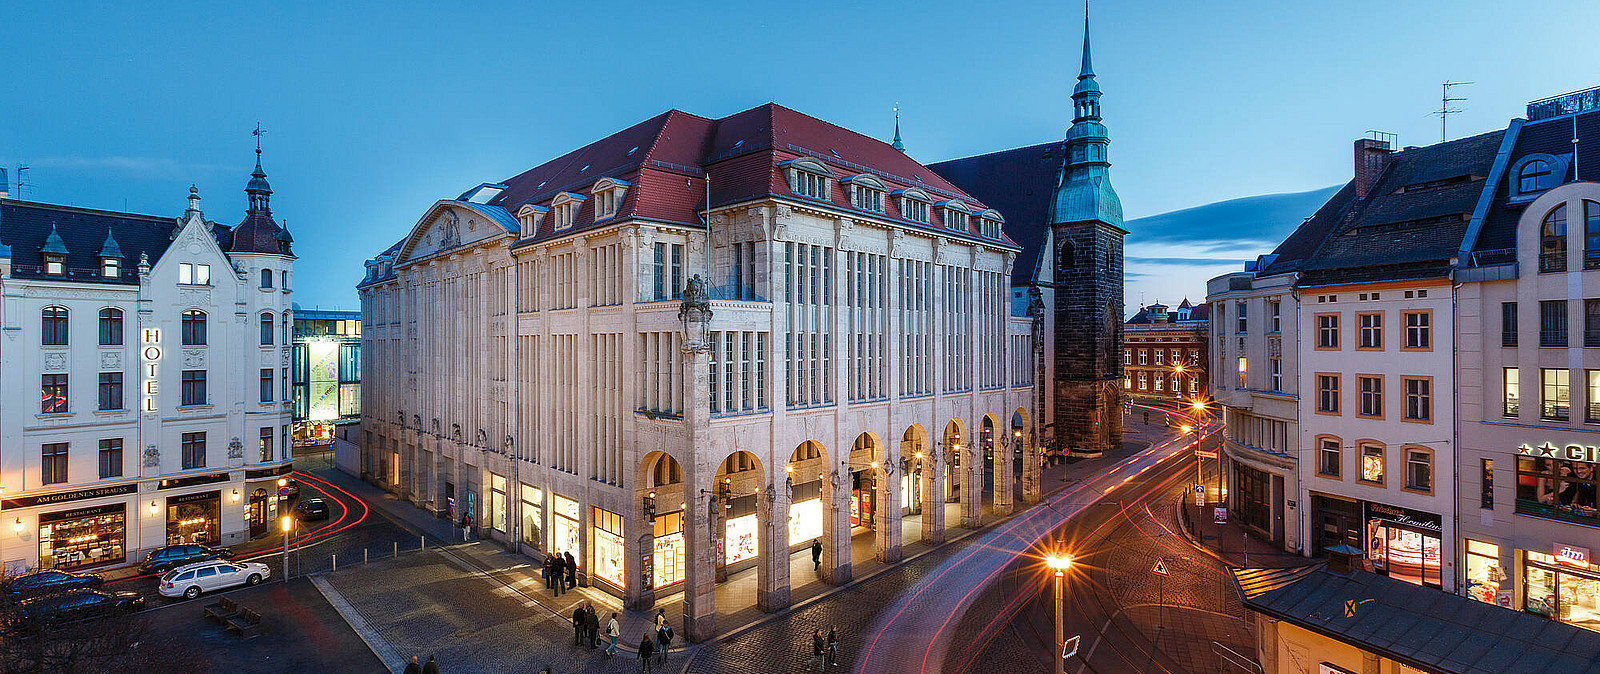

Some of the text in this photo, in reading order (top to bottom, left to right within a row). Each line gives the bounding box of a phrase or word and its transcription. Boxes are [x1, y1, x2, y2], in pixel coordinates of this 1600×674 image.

[144, 329, 161, 412] HOTEL
[1565, 443, 1600, 463] CI
[36, 486, 128, 504] AM GOLDENEN STRAUSS
[178, 493, 209, 503] RESTAURANT
[65, 508, 102, 518] RESTAURANT
[1559, 546, 1584, 559] dm
